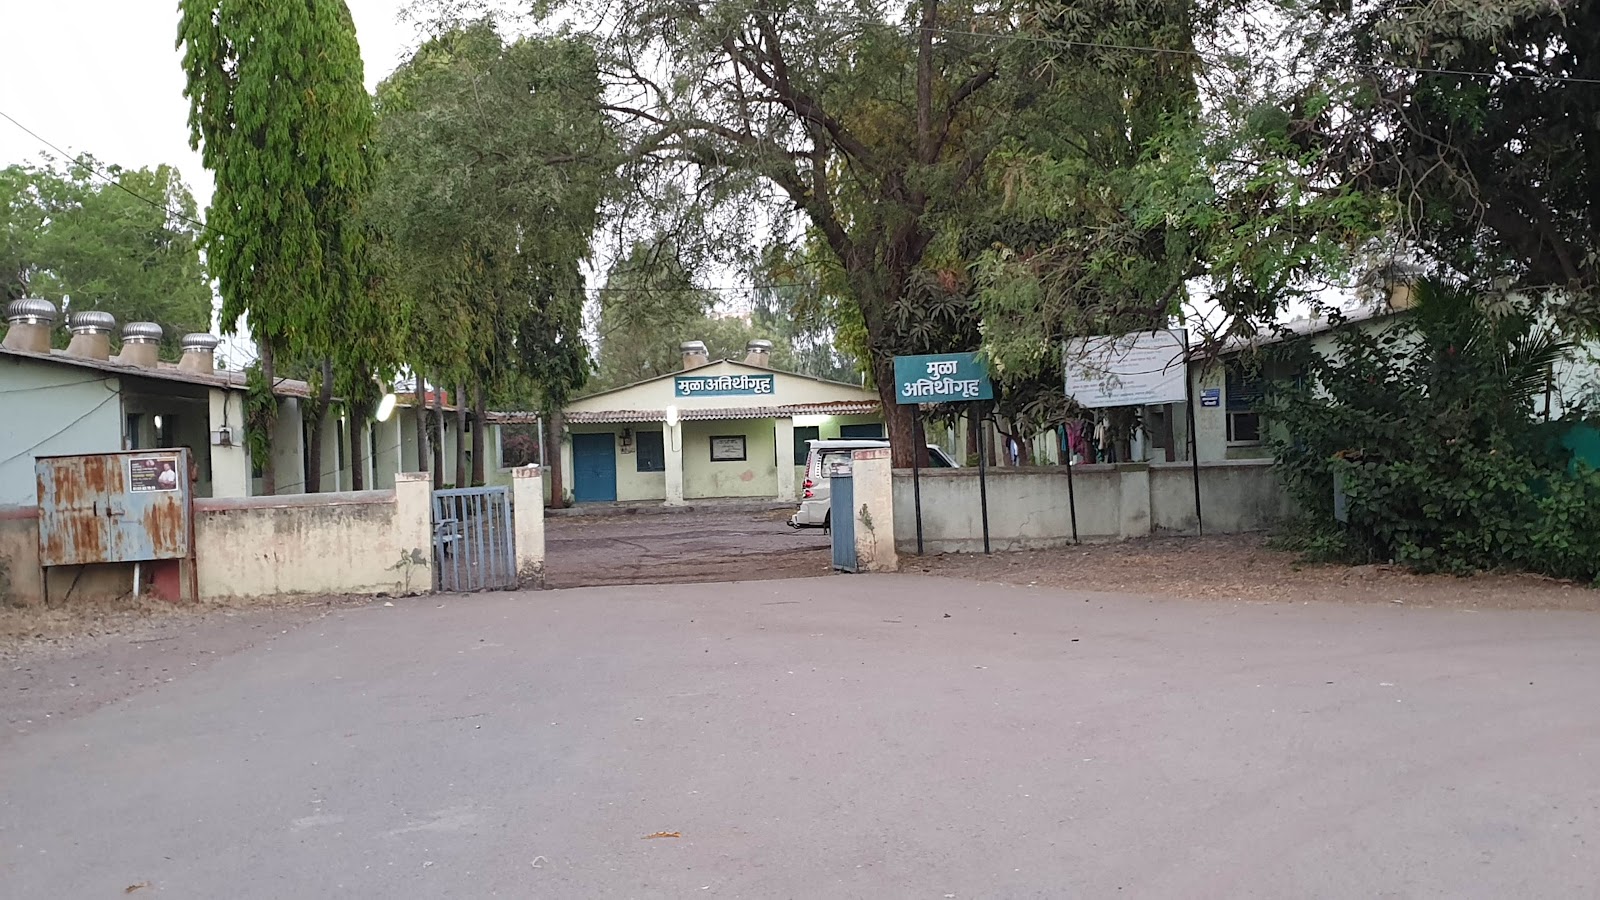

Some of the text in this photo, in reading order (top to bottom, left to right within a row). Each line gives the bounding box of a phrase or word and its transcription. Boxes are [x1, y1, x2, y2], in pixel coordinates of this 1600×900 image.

[926, 360, 958, 380] मुळा
[678, 375, 771, 395] मुळा अतिथीगृह
[901, 377, 980, 398] अतिथीगृह
